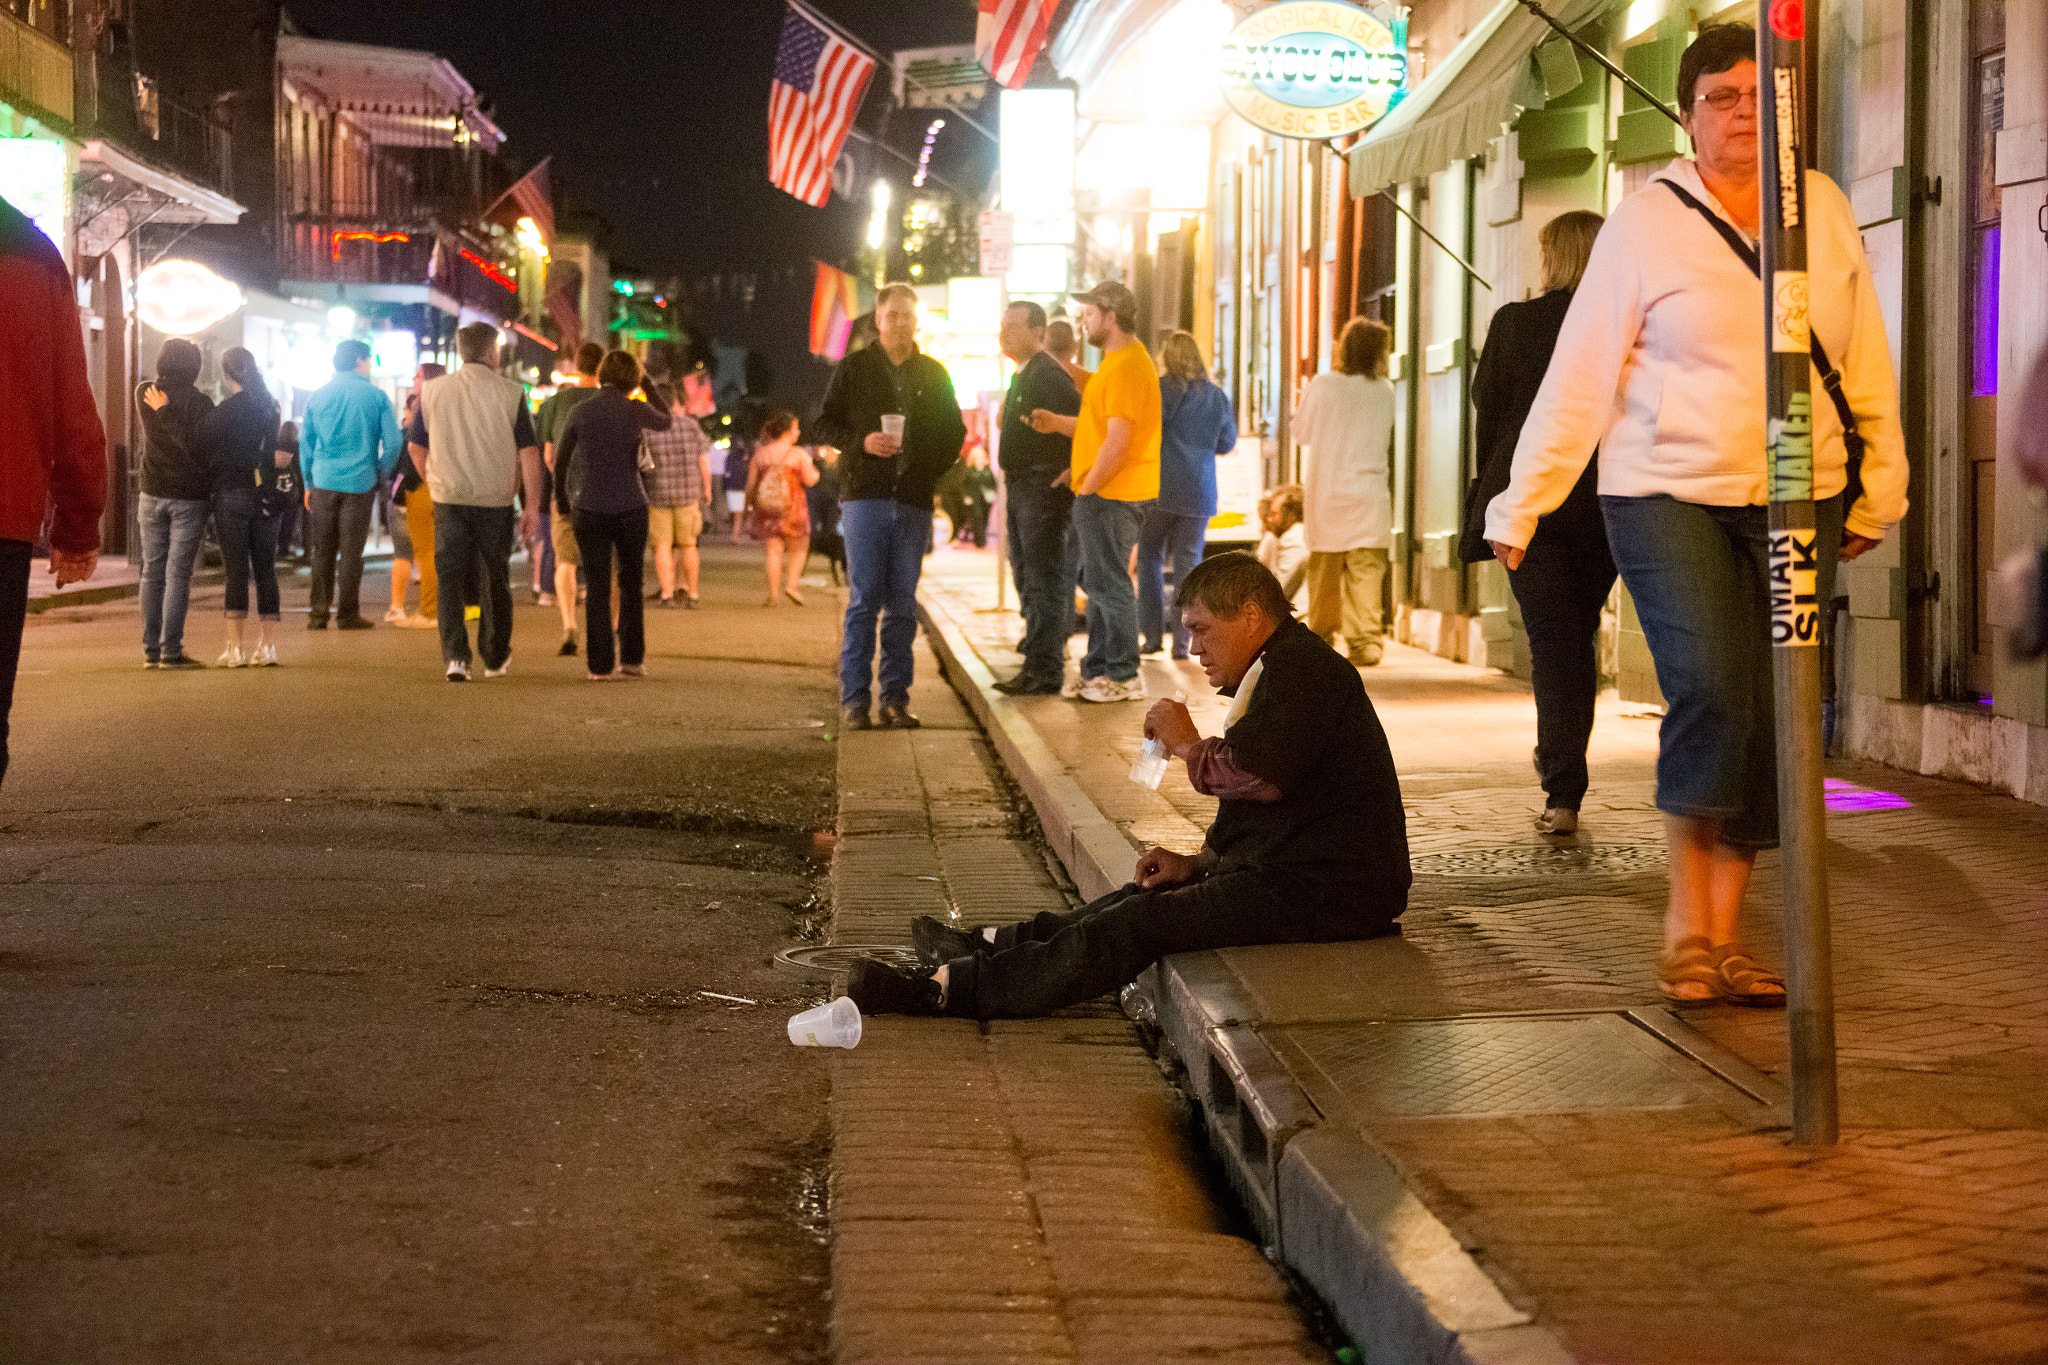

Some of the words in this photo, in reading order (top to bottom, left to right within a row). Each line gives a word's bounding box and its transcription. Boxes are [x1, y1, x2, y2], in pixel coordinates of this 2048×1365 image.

[1348, 16, 1391, 51] ISLE
[1330, 50, 1407, 87] CLUB
[1245, 95, 1316, 133] MUSIC
[1326, 99, 1375, 131] BAR
[1769, 534, 1793, 643] OMAR
